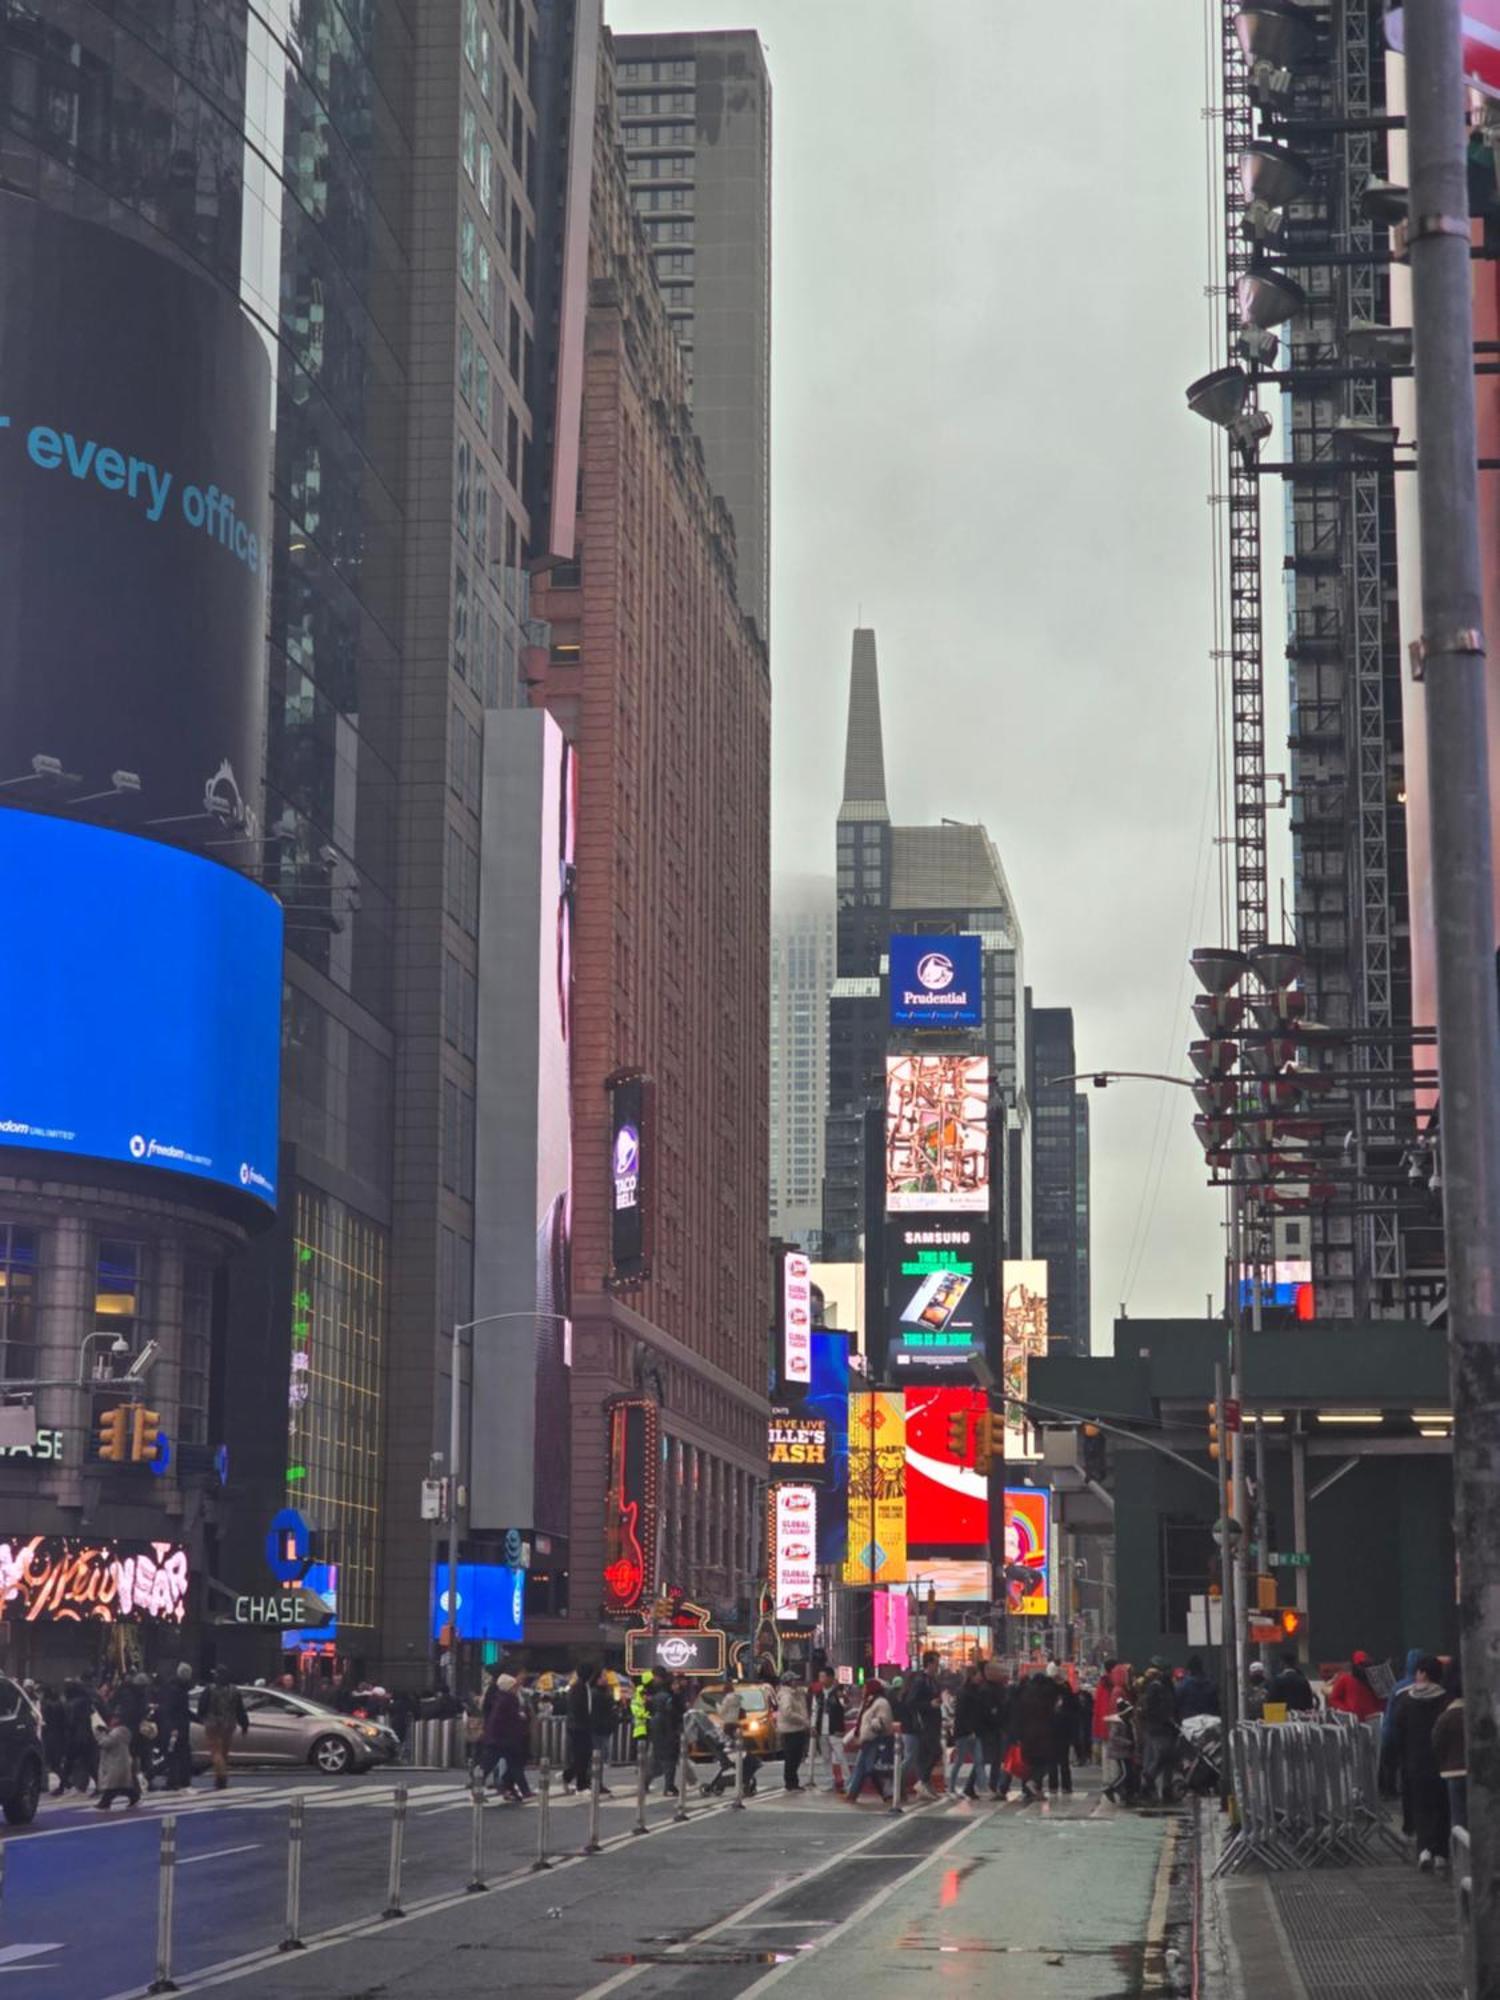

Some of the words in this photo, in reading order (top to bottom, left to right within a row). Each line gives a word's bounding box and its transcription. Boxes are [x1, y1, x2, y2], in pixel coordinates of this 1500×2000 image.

[27, 424, 173, 522] every
[903, 991, 967, 1005] Prudential
[147, 1138, 185, 1159] freedom
[615, 1175, 637, 1193] TACO
[615, 1191, 637, 1210] BELL
[904, 1231, 971, 1244] SAMSUNG
[775, 1419, 798, 1429] EVE
[800, 1420, 826, 1430] LIVE
[110, 1551, 188, 1617] YEAR
[235, 1596, 306, 1624] CHASE
